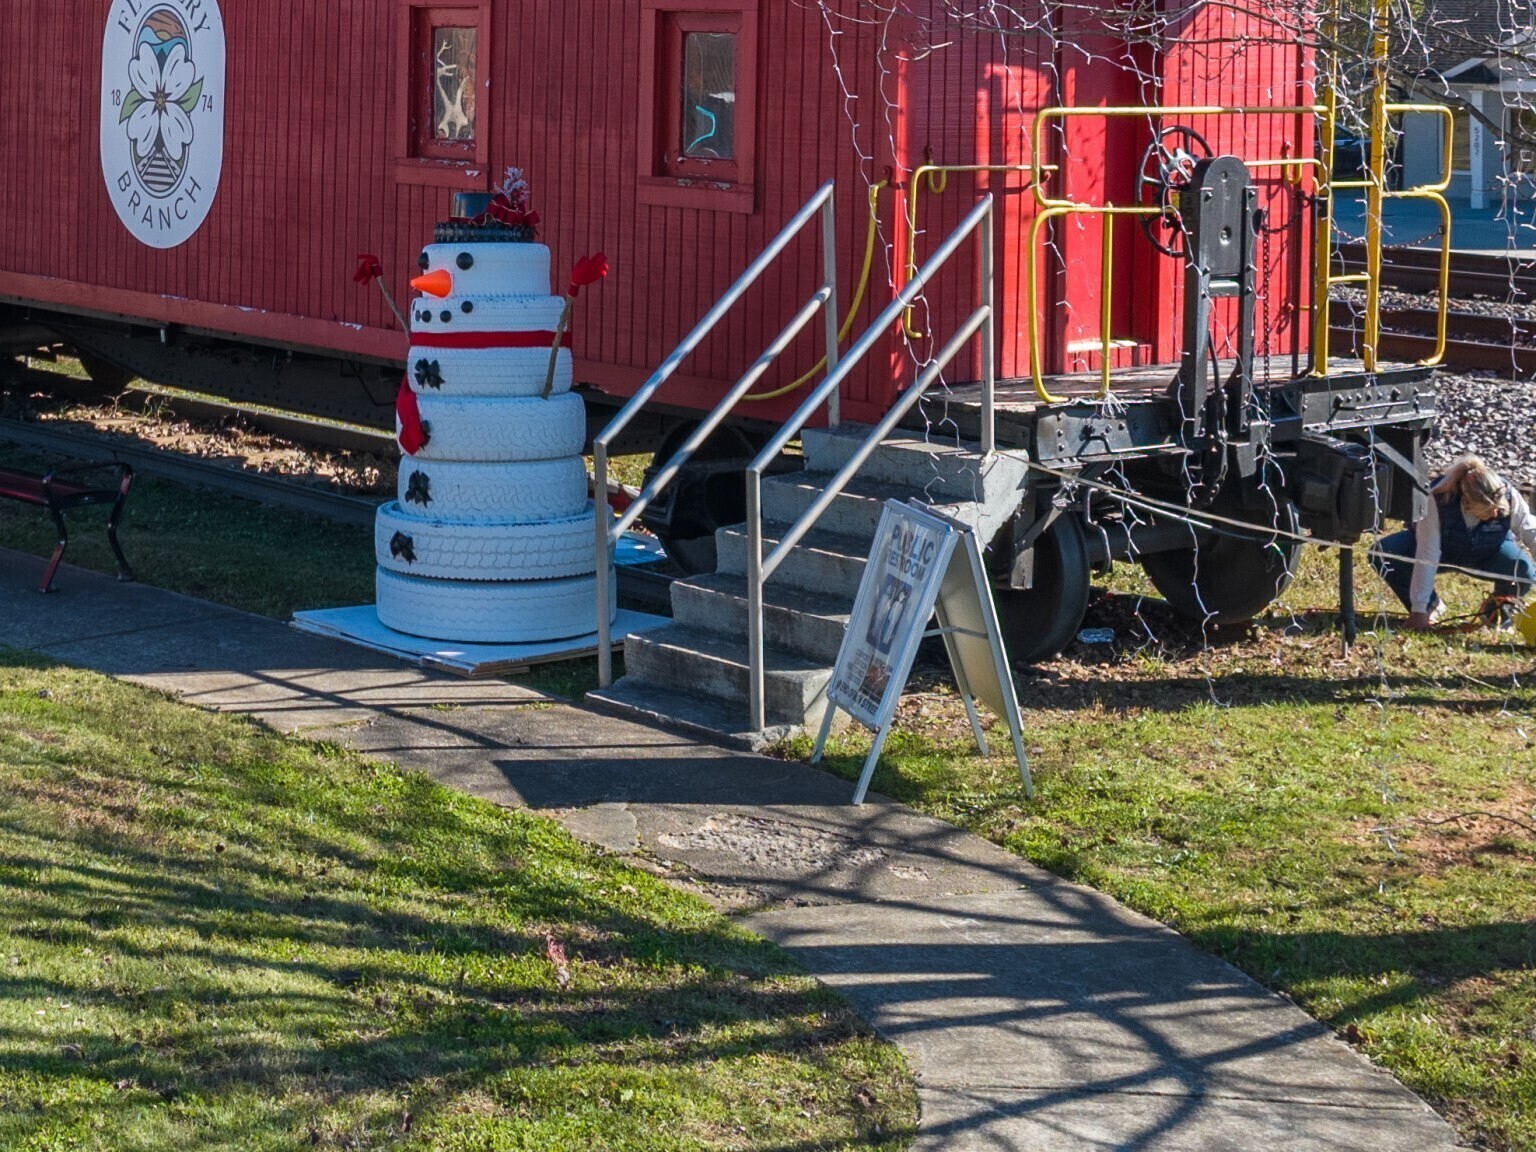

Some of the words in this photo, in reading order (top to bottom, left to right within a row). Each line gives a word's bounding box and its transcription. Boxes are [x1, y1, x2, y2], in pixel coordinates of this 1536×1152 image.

[111, 88, 122, 108] 18
[202, 95, 214, 113] 74
[117, 170, 202, 231] BRANCH
[890, 524, 934, 566] PUBLIC
[887, 548, 927, 582] RESROOM
